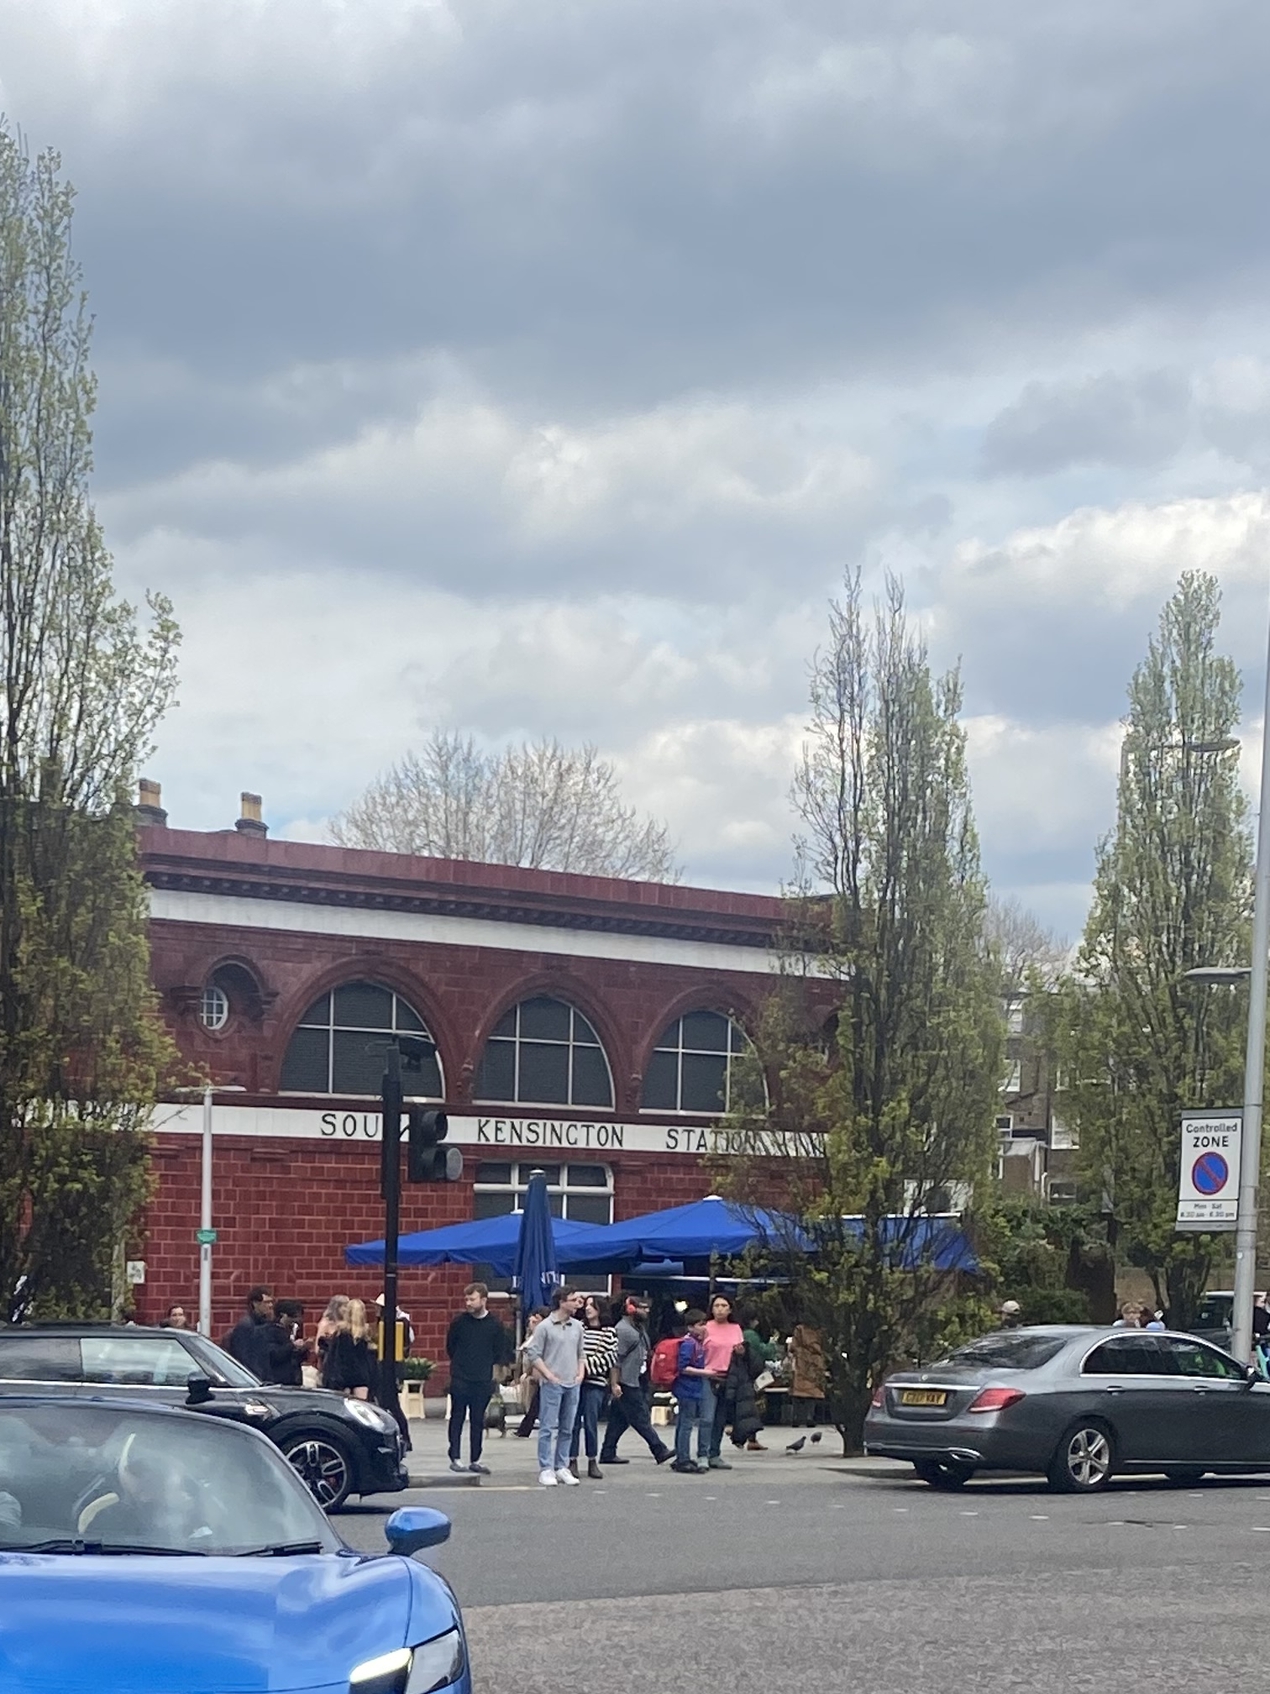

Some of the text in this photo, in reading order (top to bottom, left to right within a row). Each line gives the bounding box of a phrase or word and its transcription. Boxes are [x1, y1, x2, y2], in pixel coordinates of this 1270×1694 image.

[477, 1119, 624, 1147] KENSINGTON
[1186, 1123, 1238, 1133] Controlled
[1193, 1136, 1229, 1148] ZONE
